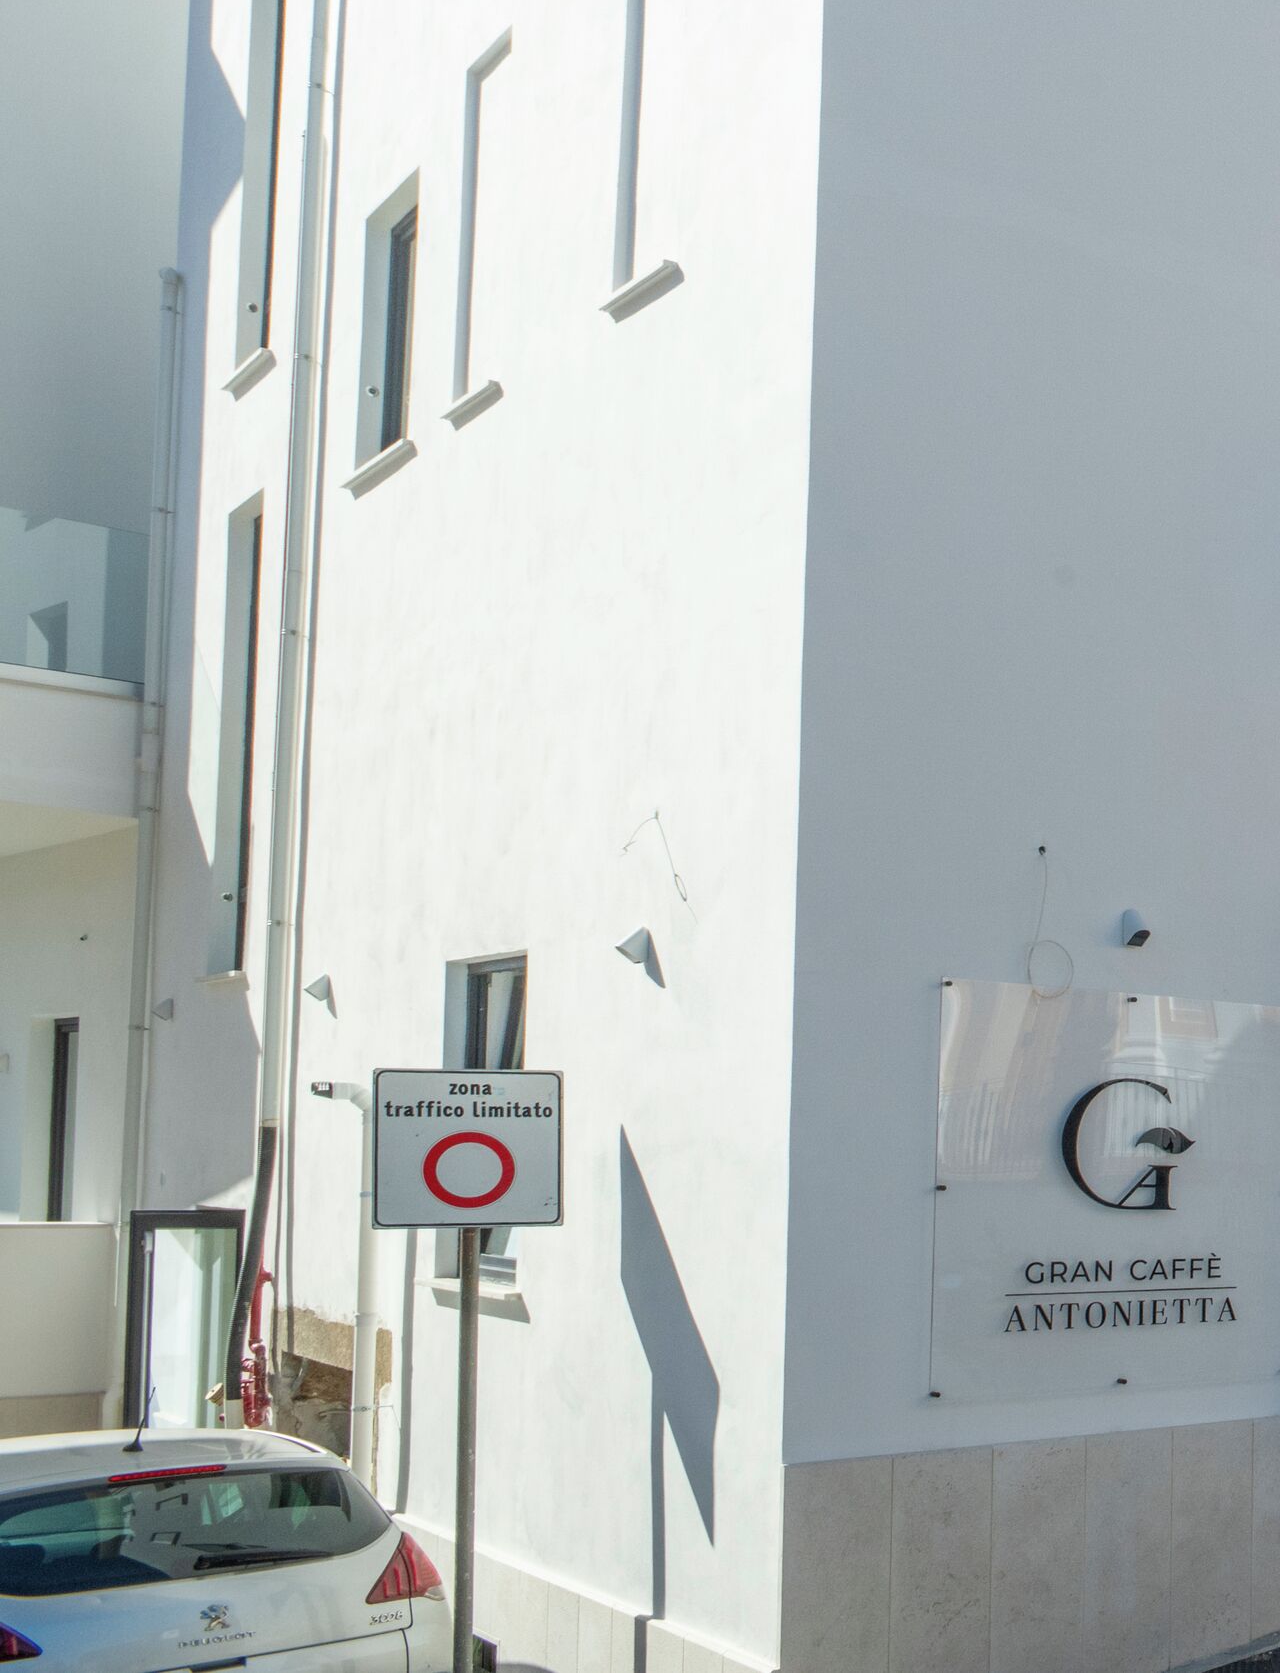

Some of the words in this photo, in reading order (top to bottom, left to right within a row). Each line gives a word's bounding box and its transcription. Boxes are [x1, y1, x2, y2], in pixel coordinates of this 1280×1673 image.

[449, 1083, 492, 1095] zona
[384, 1101, 464, 1117] traffico
[472, 1101, 553, 1118] limitato
[1025, 1260, 1114, 1284] GRAN
[1130, 1253, 1222, 1282] CAFFÈ
[1004, 1297, 1238, 1333] ANTONIETTA
